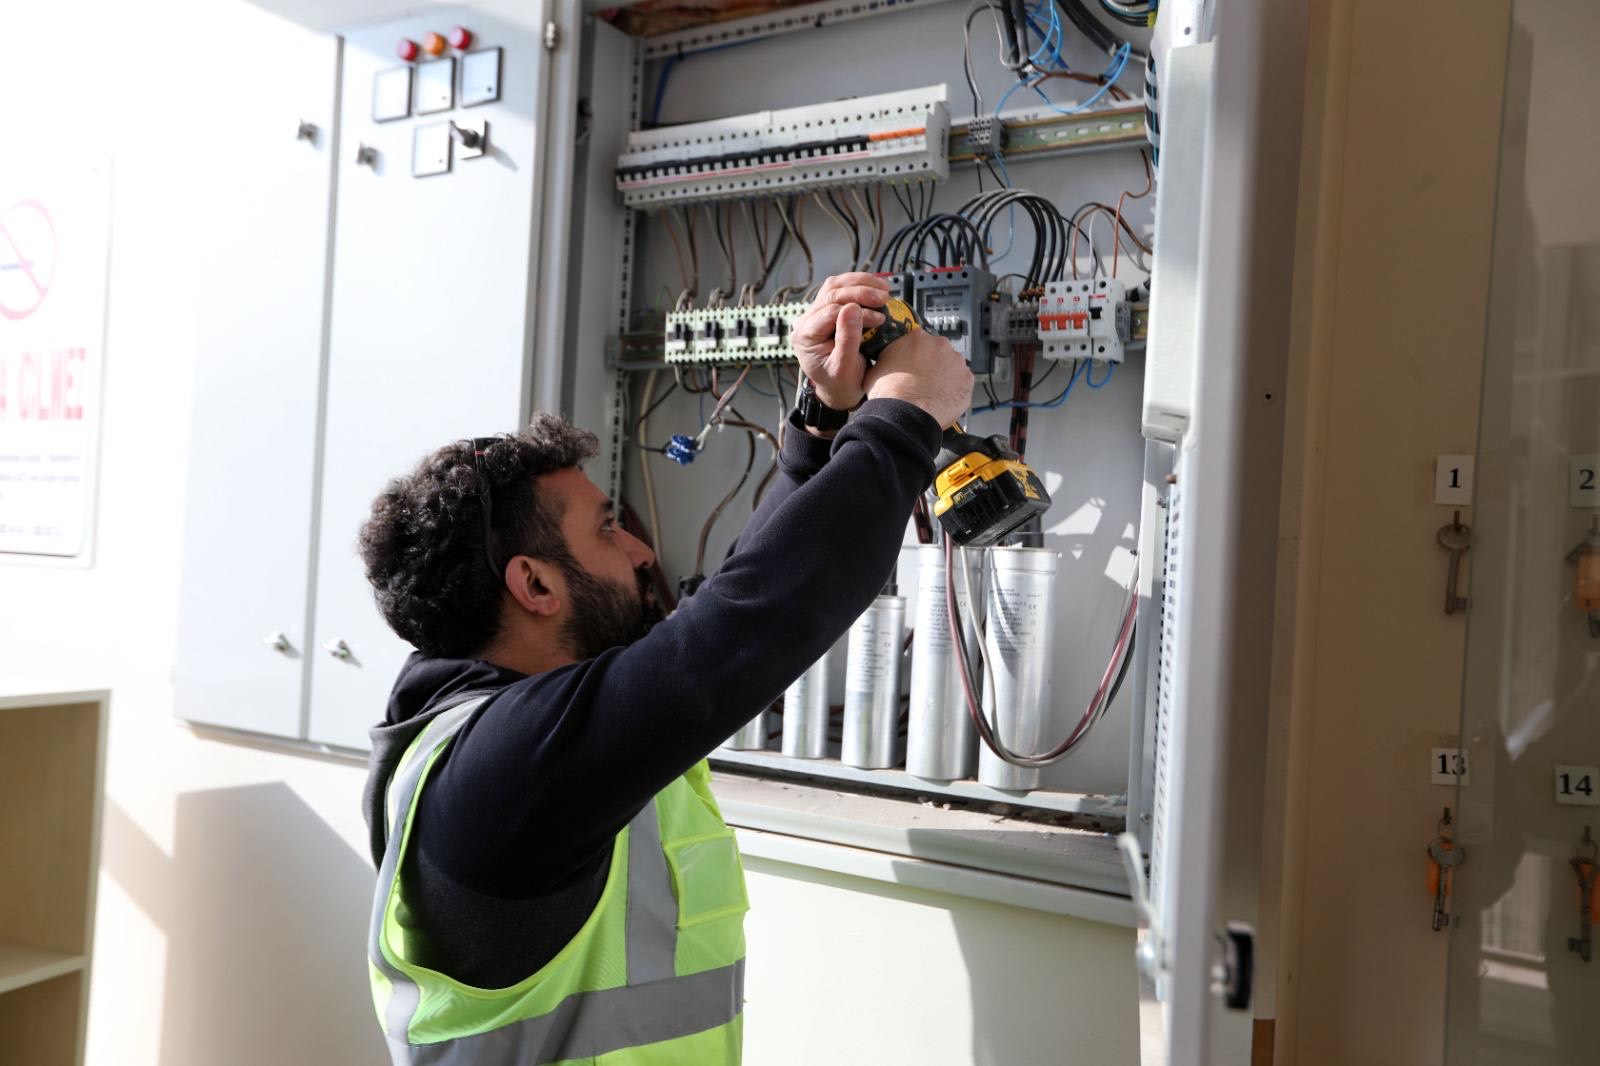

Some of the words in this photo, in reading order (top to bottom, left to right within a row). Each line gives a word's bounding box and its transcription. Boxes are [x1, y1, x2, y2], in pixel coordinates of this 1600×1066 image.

[1448, 468, 1461, 488] 1
[1579, 469, 1595, 490] 2
[1437, 754, 1466, 776] 13
[1559, 773, 1594, 796] 14
